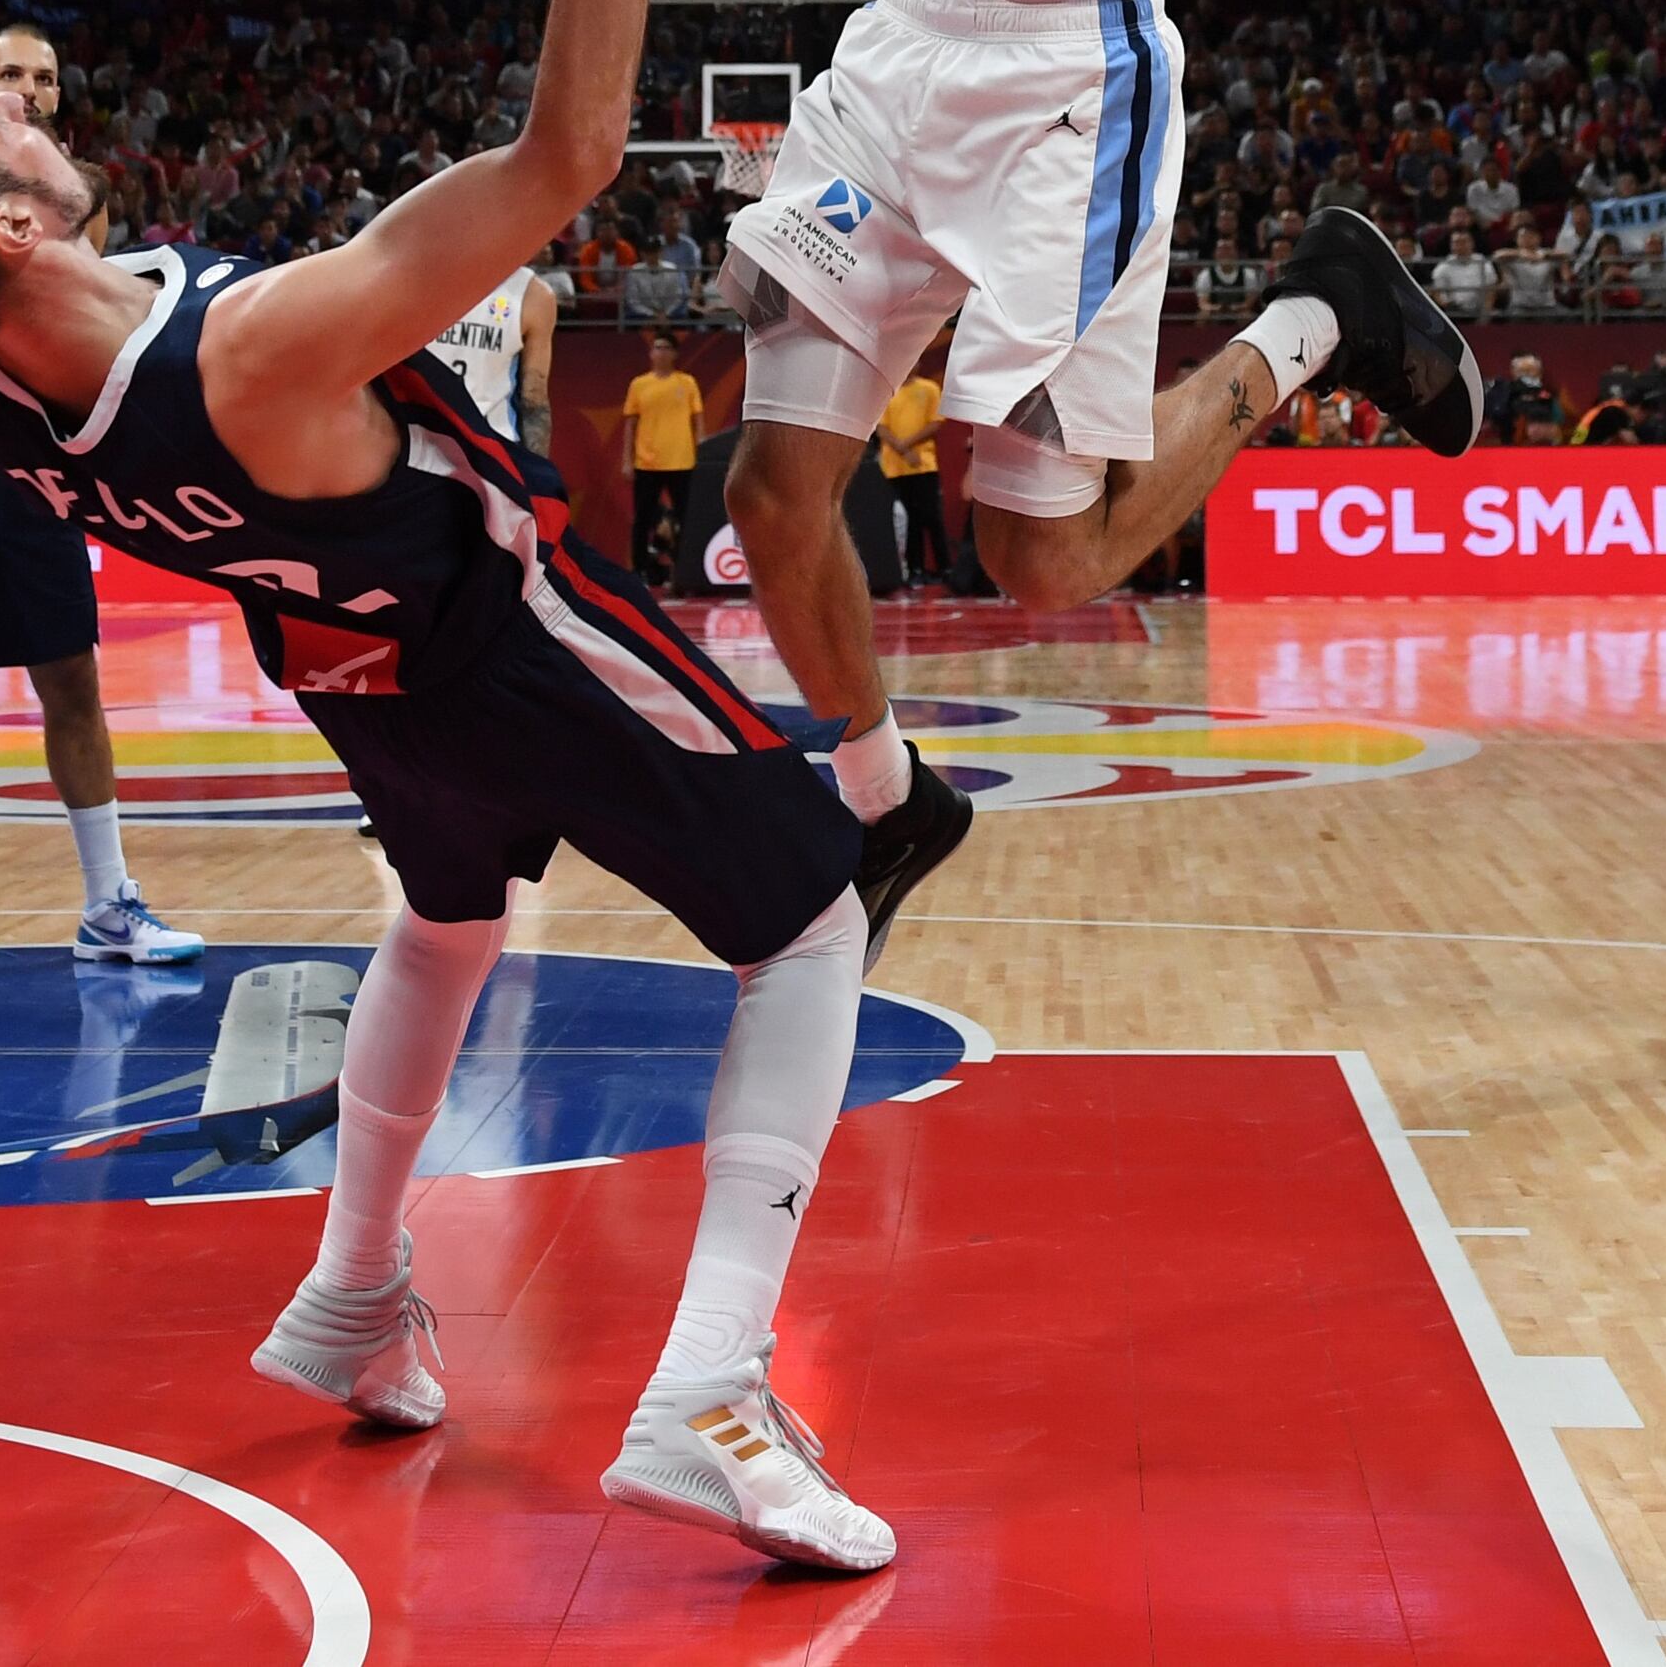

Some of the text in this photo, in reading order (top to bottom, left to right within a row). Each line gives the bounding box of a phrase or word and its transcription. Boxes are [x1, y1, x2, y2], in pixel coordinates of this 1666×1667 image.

[783, 206, 858, 267] PAN AMERICAN
[1252, 484, 1447, 556] TCL
